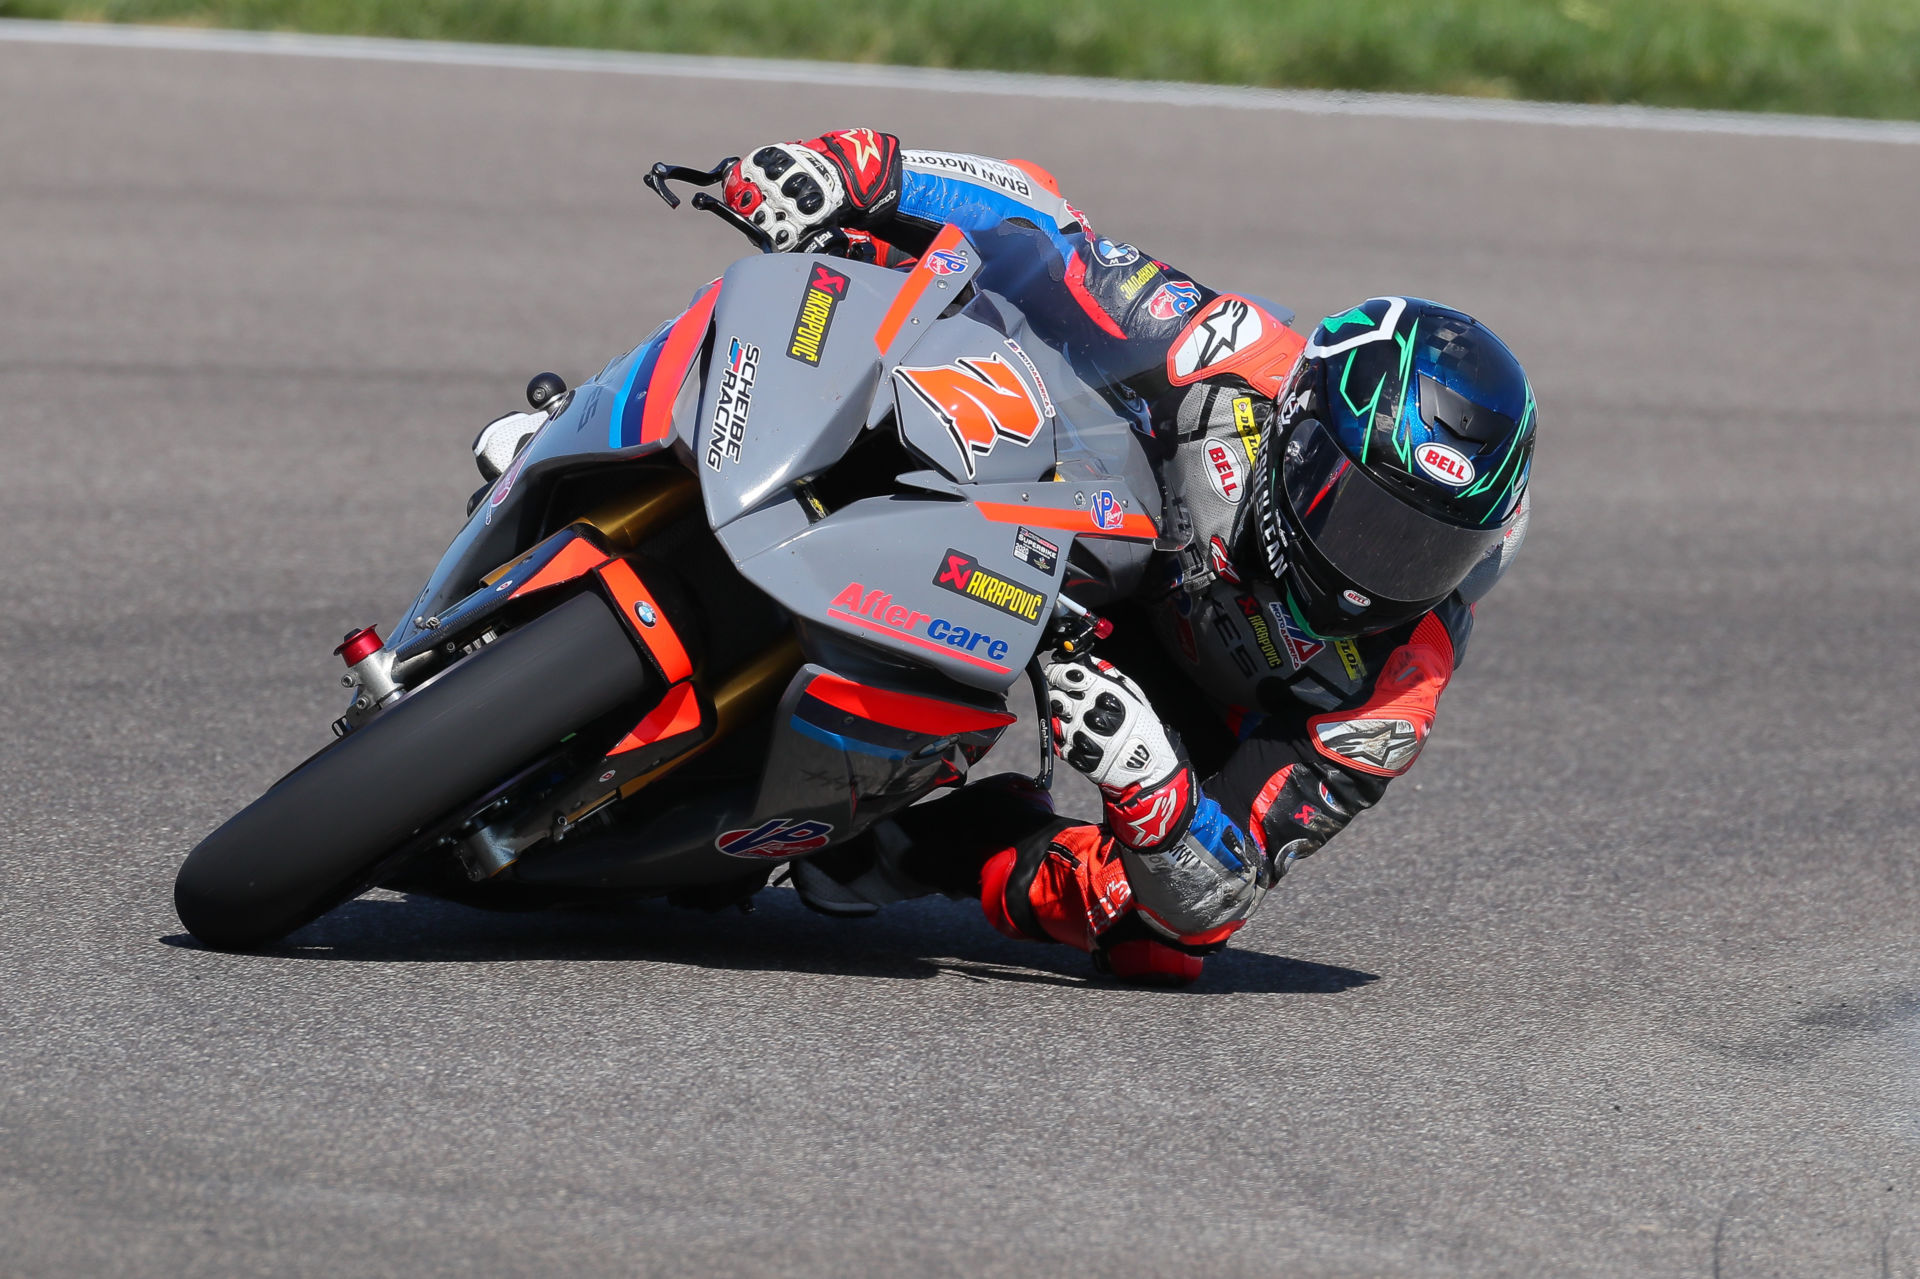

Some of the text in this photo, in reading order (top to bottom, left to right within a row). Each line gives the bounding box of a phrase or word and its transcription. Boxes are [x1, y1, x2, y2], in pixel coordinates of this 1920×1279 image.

[981, 169, 1029, 196] BMW
[726, 343, 760, 462] SCHEIBE
[1018, 349, 1051, 408] MOTOAMERICA
[707, 369, 737, 470] RACING
[1208, 446, 1238, 497] BELL
[1424, 449, 1464, 480] BELL
[1018, 533, 1057, 559] SUPERBIKE
[830, 581, 1009, 661] Aftercare
[1271, 603, 1300, 669] MOTOAMERICA
[720, 819, 833, 855] VP
